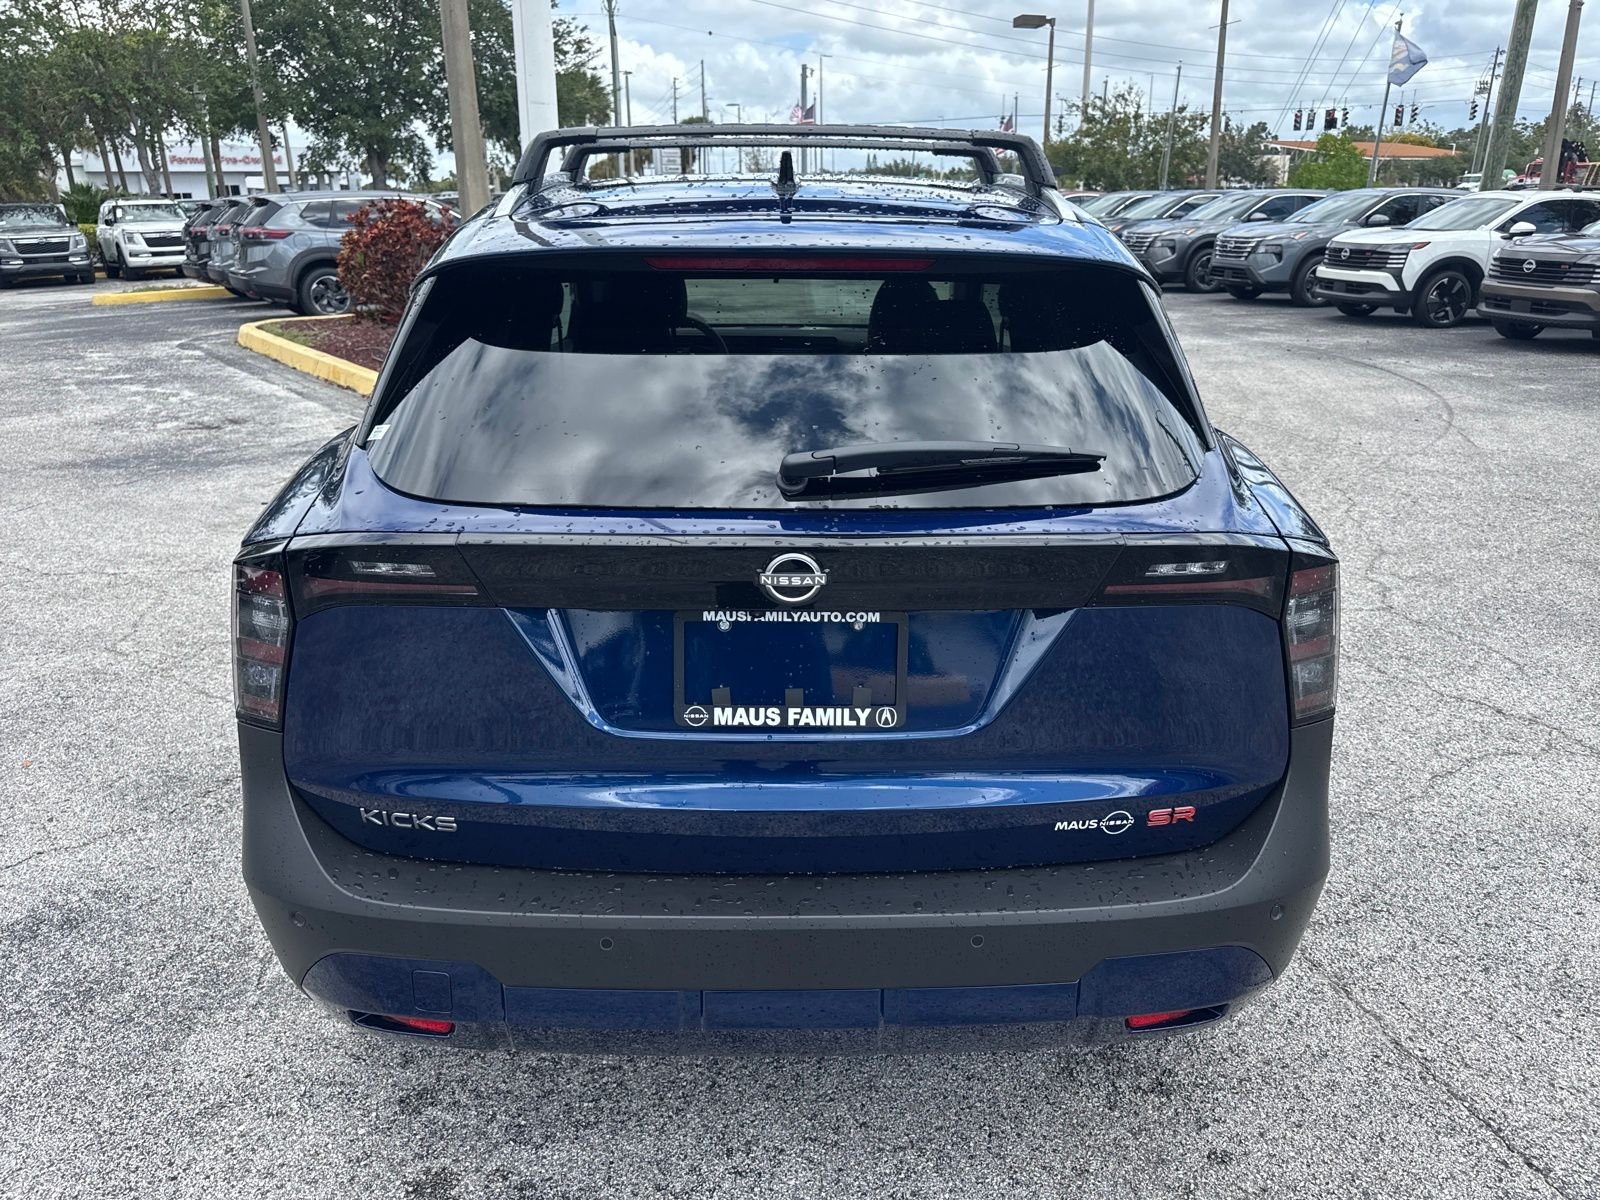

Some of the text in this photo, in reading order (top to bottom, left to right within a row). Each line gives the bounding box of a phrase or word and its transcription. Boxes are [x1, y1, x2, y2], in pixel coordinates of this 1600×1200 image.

[761, 576, 826, 586] NISSAN
[713, 707, 782, 727] MAUS
[787, 707, 872, 727] FAMILY
[359, 807, 458, 832] KICKS
[1054, 817, 1135, 831] MAUS NISSAN
[1146, 805, 1197, 827] SR
